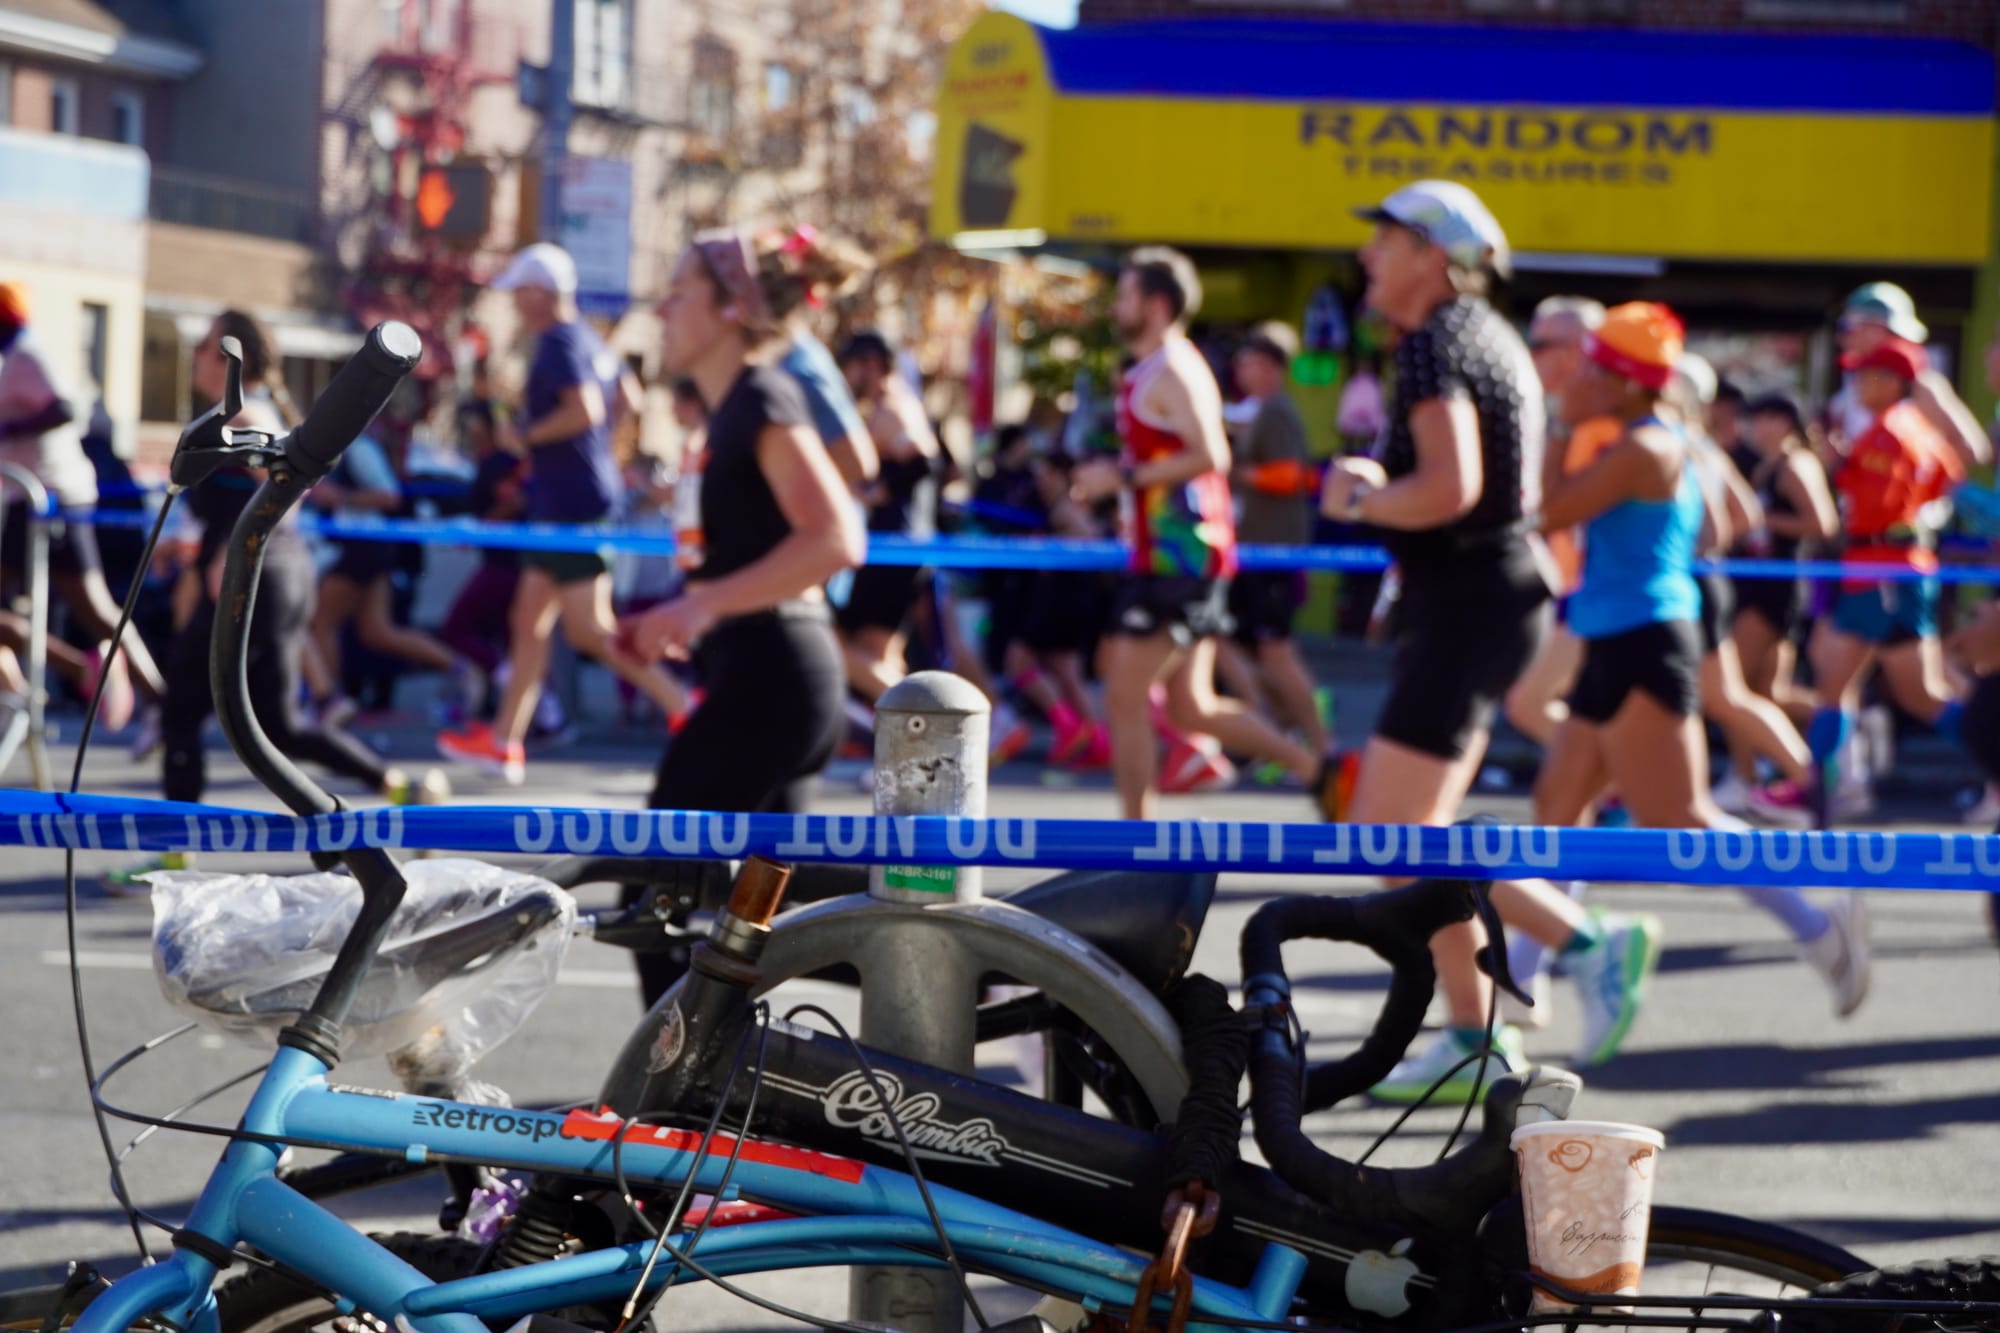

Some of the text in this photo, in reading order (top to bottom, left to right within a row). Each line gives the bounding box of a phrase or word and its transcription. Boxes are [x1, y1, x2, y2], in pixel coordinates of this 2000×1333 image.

[1299, 110, 1713, 156] RANDOM
[1340, 154, 1672, 184] TREASURES
[413, 1102, 600, 1143] Retrosp
[822, 1068, 1004, 1166] Columbia
